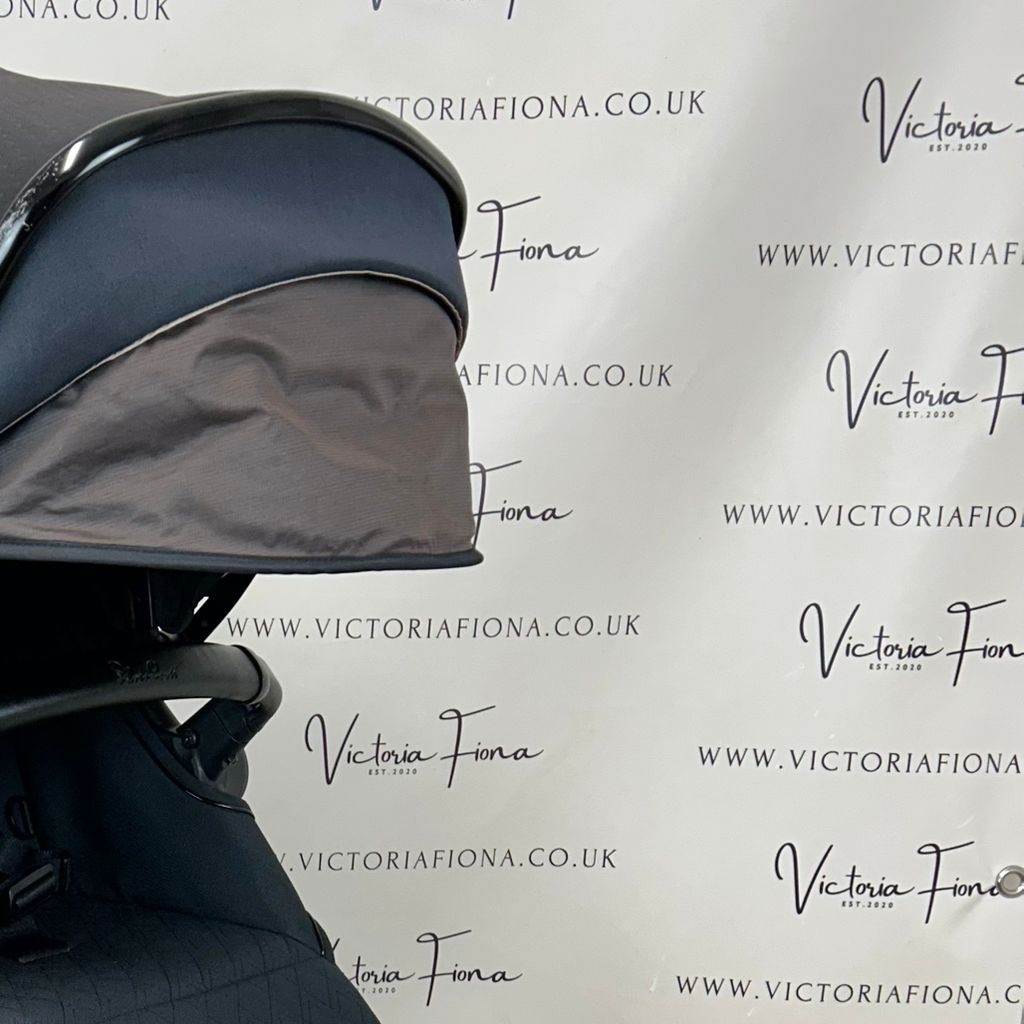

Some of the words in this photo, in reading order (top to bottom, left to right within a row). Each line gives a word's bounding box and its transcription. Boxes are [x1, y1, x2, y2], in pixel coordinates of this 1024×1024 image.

[862, 76, 1013, 164] Victoria
[929, 143, 988, 152] EST.2020
[477, 195, 599, 291] Fiona
[826, 349, 978, 430] Victoria
[898, 411, 955, 419] EST.2020
[469, 459, 573, 549] Fiona
[723, 503, 1024, 528] WWW.VICTORIAFIO
[227, 613, 640, 640] WWW.VICTORIAFIONA.CO.UK
[799, 602, 944, 679] Victoria
[869, 664, 923, 672] EST.2020
[305, 712, 438, 786] Victoria
[439, 704, 544, 789] Fiona
[368, 768, 418, 776] EST.2020
[775, 842, 915, 915] Victoria
[842, 900, 894, 909] EST.2020
[416, 929, 524, 1008] Fiona
